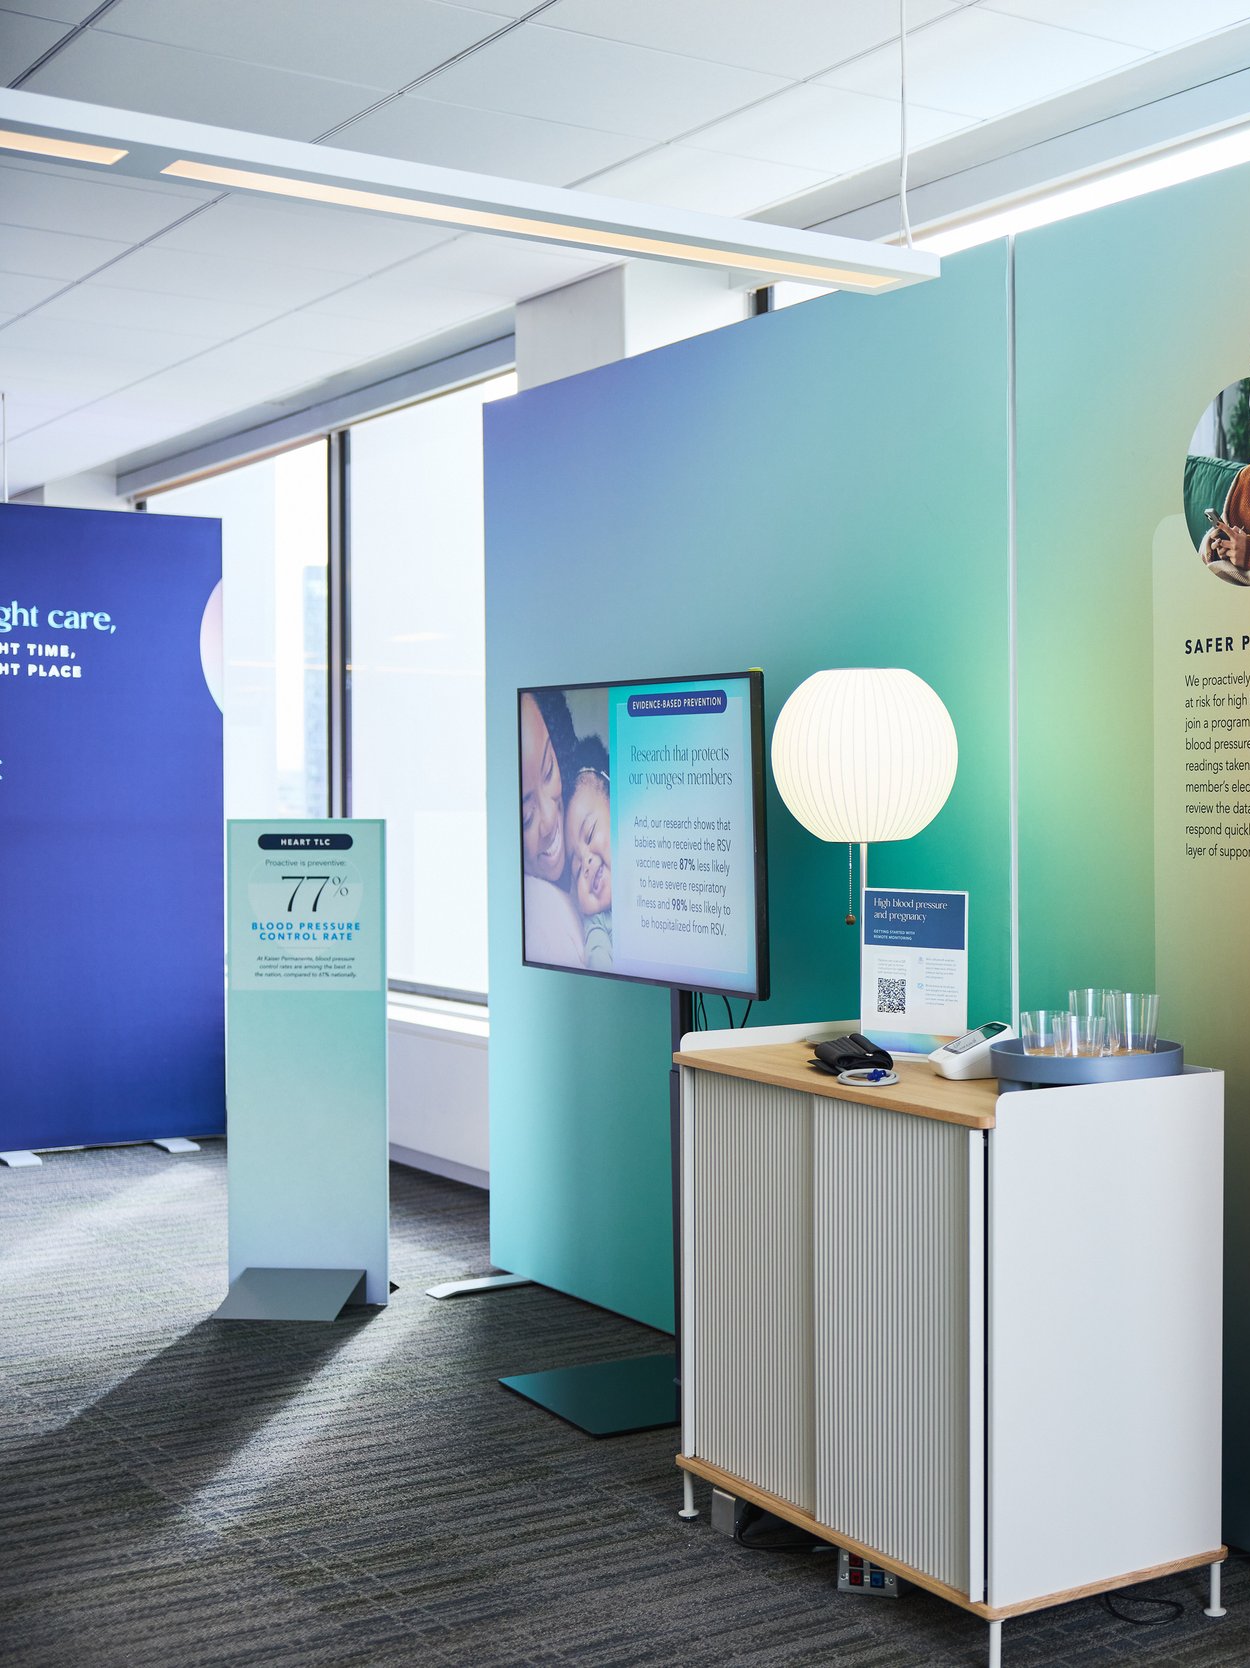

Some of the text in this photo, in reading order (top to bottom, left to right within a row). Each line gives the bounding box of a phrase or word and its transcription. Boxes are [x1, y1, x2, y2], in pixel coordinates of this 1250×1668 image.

[48, 610, 116, 634] care,
[27, 643, 76, 659] TIME,
[1185, 637, 1234, 655] SAFER
[28, 664, 82, 678] PLACE
[1185, 675, 1200, 687] We
[1202, 671, 1250, 690] proactively
[633, 697, 722, 710] EVIDENCE-BASED PREVENTION
[1185, 698, 1194, 708] at
[1196, 694, 1211, 708] risk
[1213, 694, 1226, 707] for
[1228, 693, 1247, 710] high
[1185, 717, 1201, 733] join
[1203, 720, 1209, 729] a
[1212, 718, 1250, 732] program
[631, 744, 729, 767] Research that protects
[629, 768, 733, 790] our youngest members
[651, 819, 662, 828] our
[663, 817, 692, 830] research
[694, 817, 716, 831] shows
[717, 817, 731, 831] that
[635, 836, 731, 852] babies who received the RSV
[265, 859, 298, 867] Proactive
[307, 860, 346, 868] preventive:
[636, 858, 730, 877] vaccine were 87% less likely
[282, 876, 348, 912] 77%
[640, 876, 727, 897] to have severe respiratory
[637, 898, 731, 918] illness and 98% less likely to
[874, 898, 948, 911] High blood pressure
[641, 916, 650, 928] be
[651, 917, 691, 933] hospitalized
[692, 920, 709, 934] from
[874, 910, 927, 924] and pregnancy
[252, 922, 360, 931] BLOOD PRESSURE
[259, 932, 352, 941] CONTROL RATE
